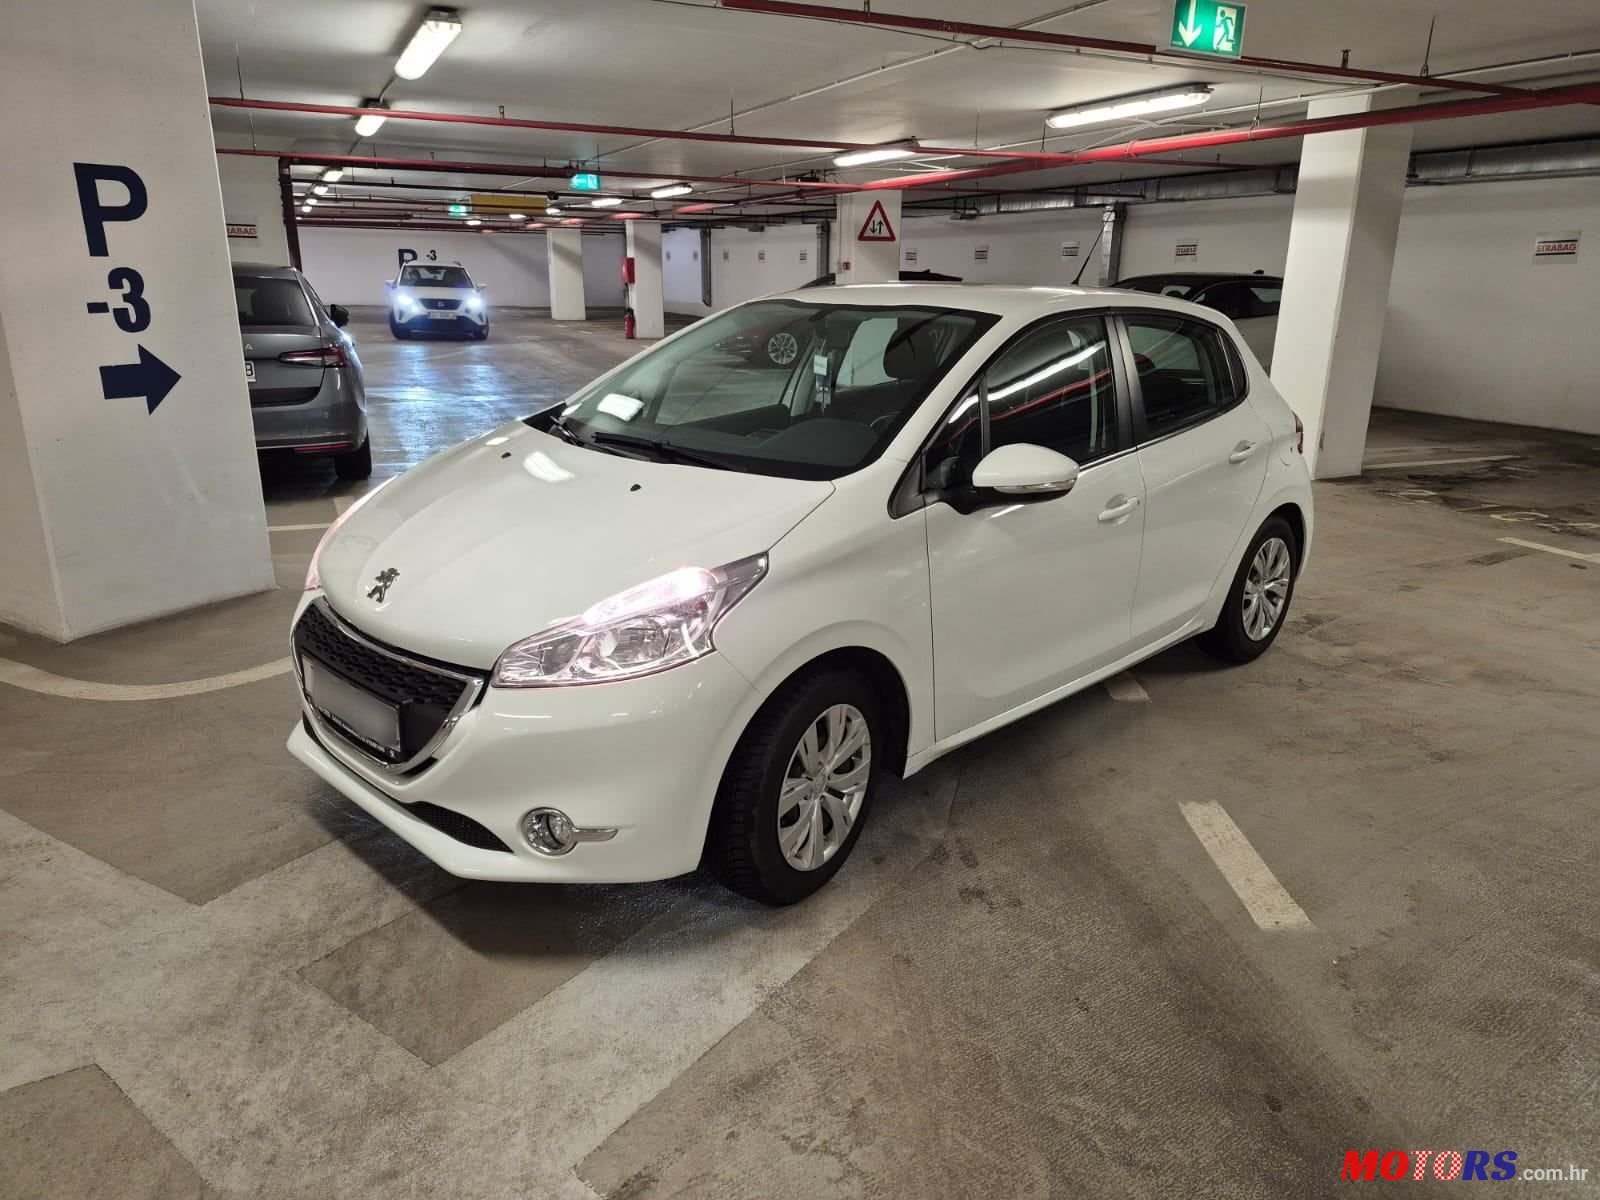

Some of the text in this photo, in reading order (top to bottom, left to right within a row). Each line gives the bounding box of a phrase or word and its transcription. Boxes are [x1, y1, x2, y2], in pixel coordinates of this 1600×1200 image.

[73, 162, 148, 257] P
[398, 248, 437, 269] P -3
[1535, 243, 1577, 252] STRABAG
[86, 267, 151, 333] -3
